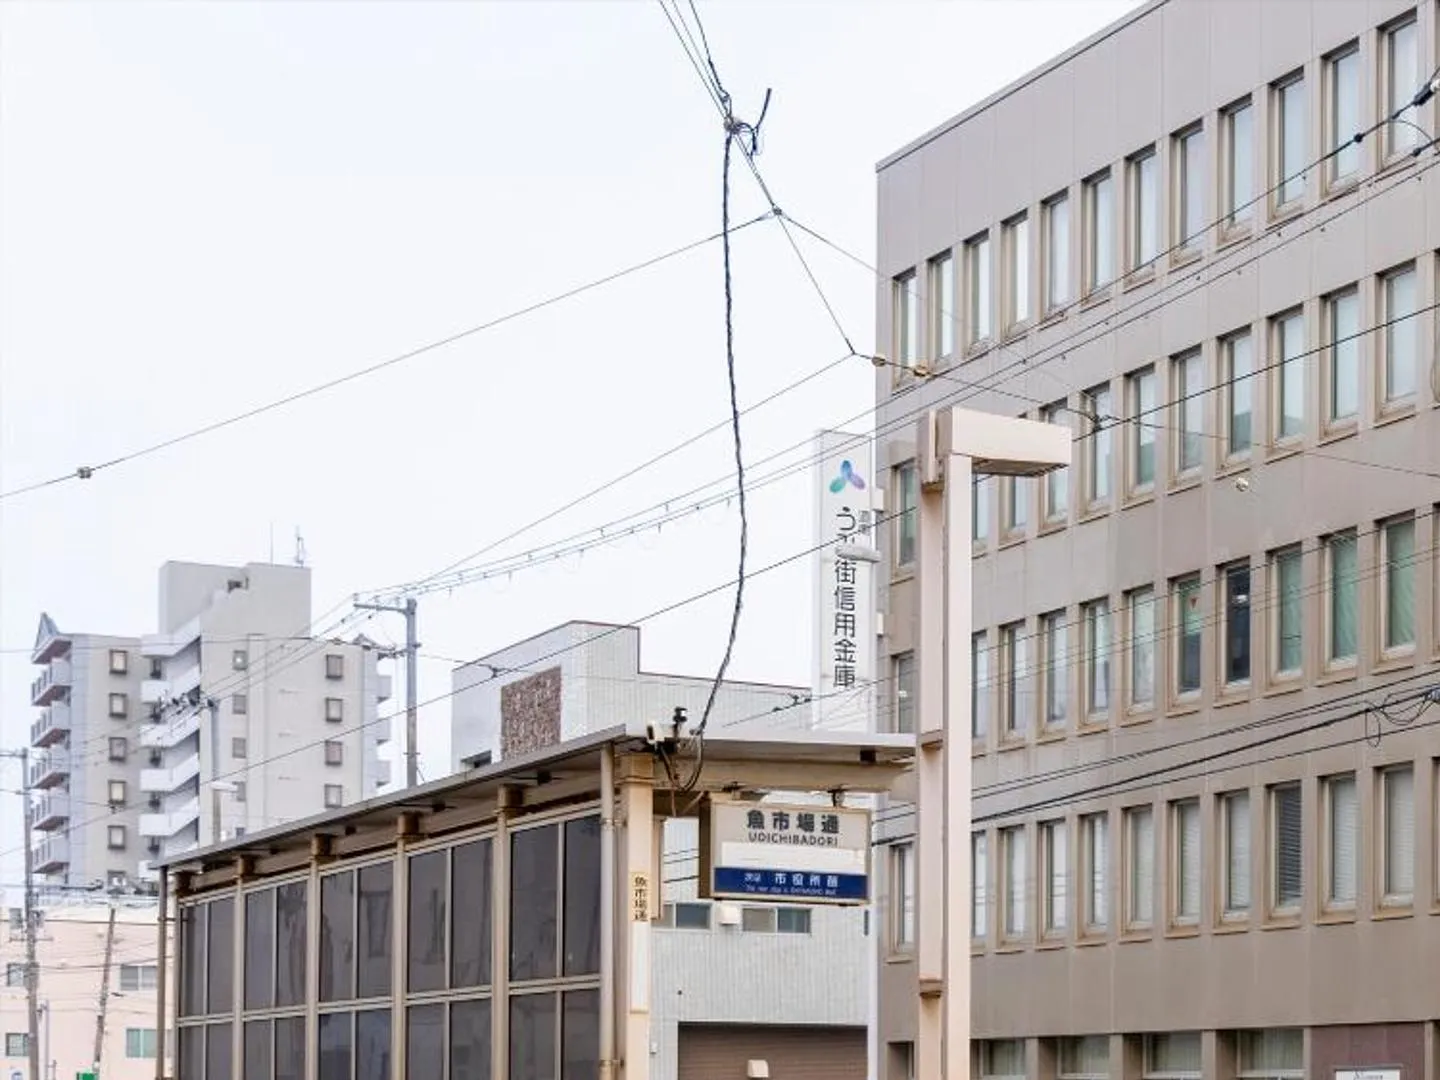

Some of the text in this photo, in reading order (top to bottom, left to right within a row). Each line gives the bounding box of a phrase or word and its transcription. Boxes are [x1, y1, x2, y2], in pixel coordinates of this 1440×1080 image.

[746, 810, 839, 834] 魚市場通
[634, 876, 648, 921] 魚市場通
